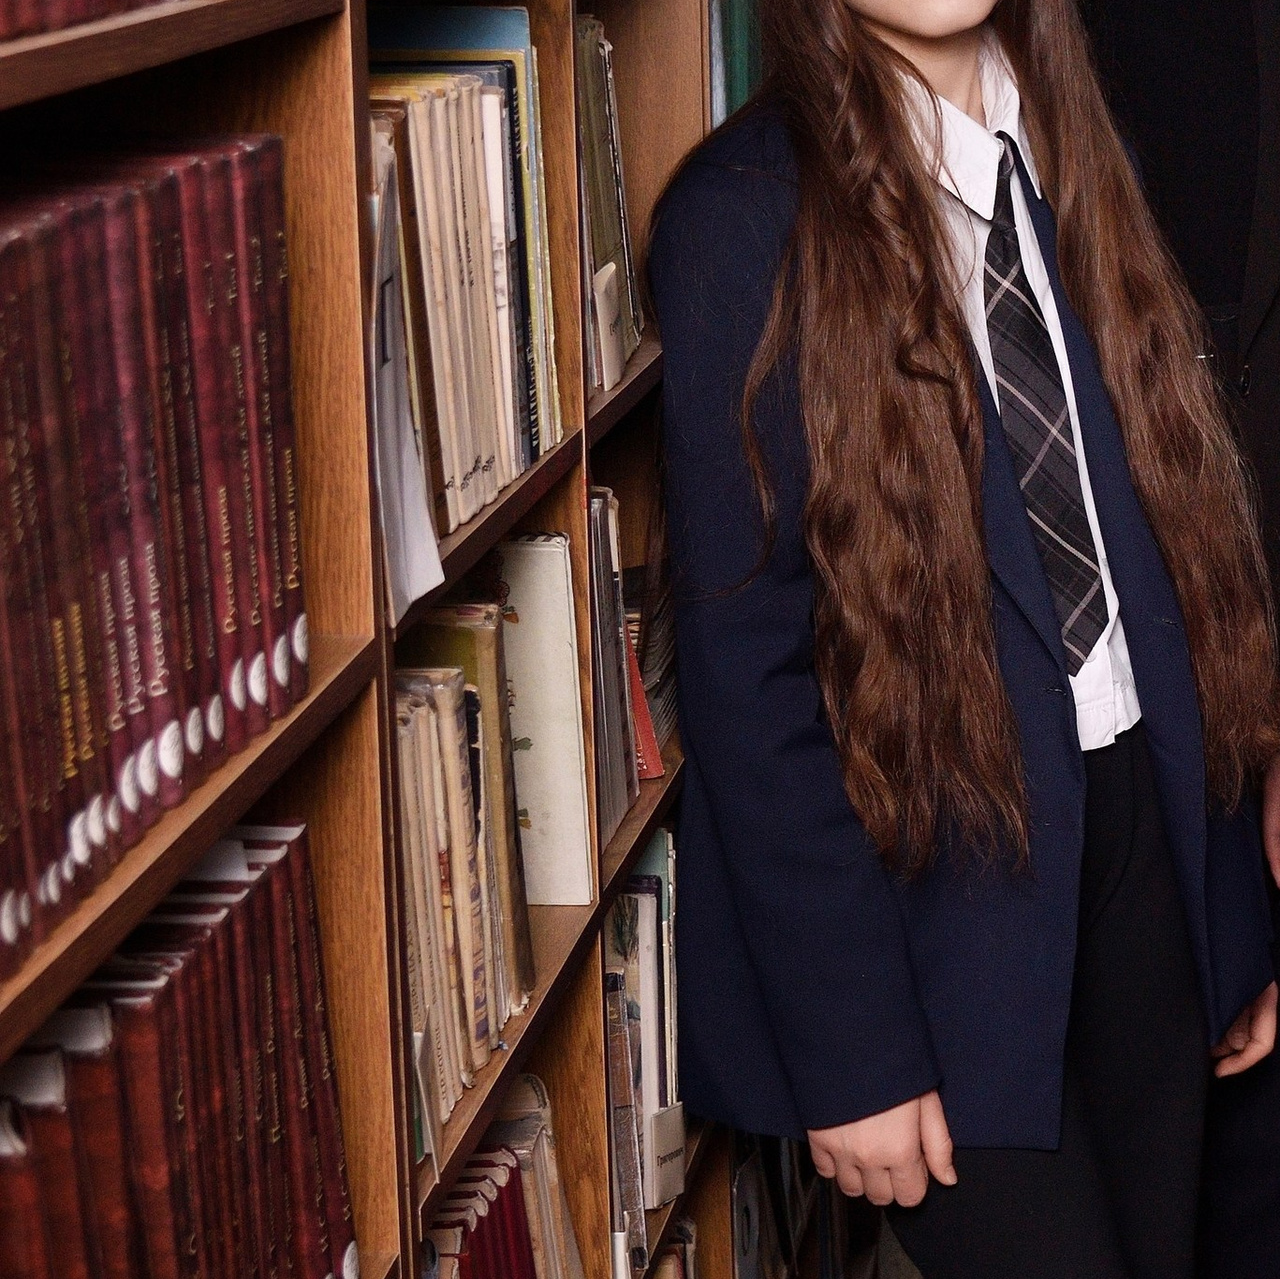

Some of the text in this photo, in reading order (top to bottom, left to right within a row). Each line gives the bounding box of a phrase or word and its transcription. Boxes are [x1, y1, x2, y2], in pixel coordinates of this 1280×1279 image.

[217, 484, 232, 544] проза
[284, 447, 295, 503] проза
[285, 509, 299, 588] Русская
[143, 542, 169, 698] Русская проза
[222, 550, 238, 632] Русская
[100, 571, 125, 731] Русская проза
[118, 556, 146, 713] Русская проза
